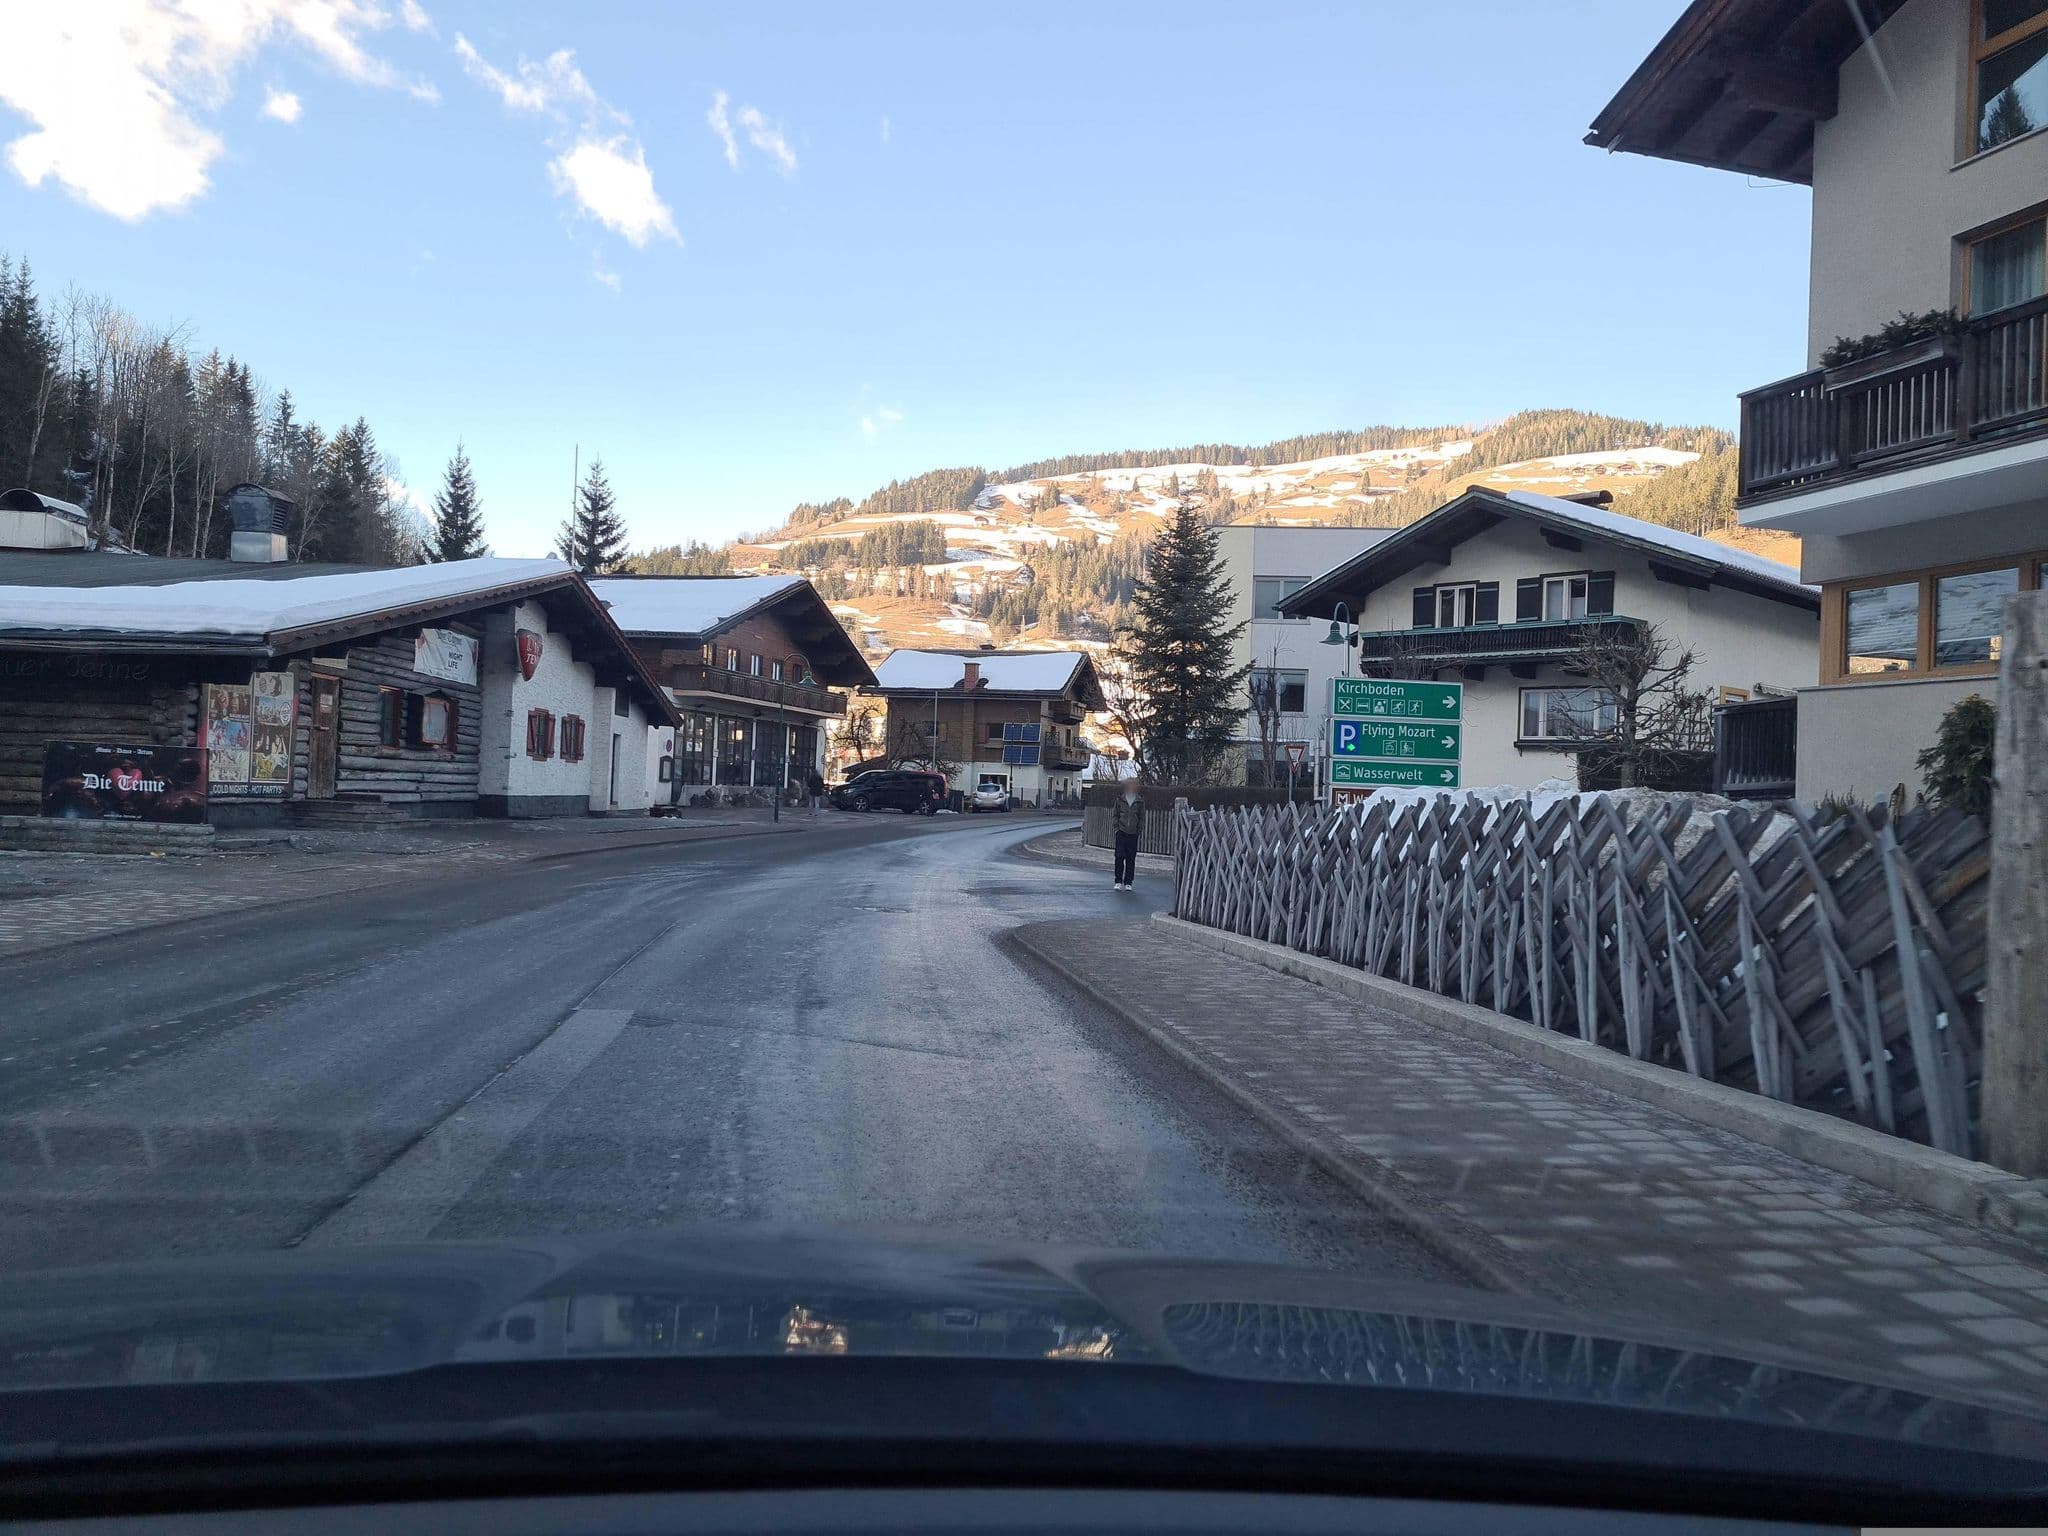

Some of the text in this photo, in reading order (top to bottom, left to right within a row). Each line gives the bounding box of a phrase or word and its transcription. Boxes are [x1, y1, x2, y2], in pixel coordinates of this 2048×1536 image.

[449, 651, 463, 661] NIGHT
[448, 660, 458, 669] LIFE
[1338, 682, 1404, 696] Kirchboden
[1340, 723, 1436, 749] P Flying Mozart
[1354, 766, 1423, 780] Wasserwelt
[81, 772, 165, 792] Die Tenne
[212, 784, 228, 793] COLD
[229, 784, 248, 794] NIGHTS
[251, 785, 262, 794] HOT
[262, 785, 282, 794] PARTYS
